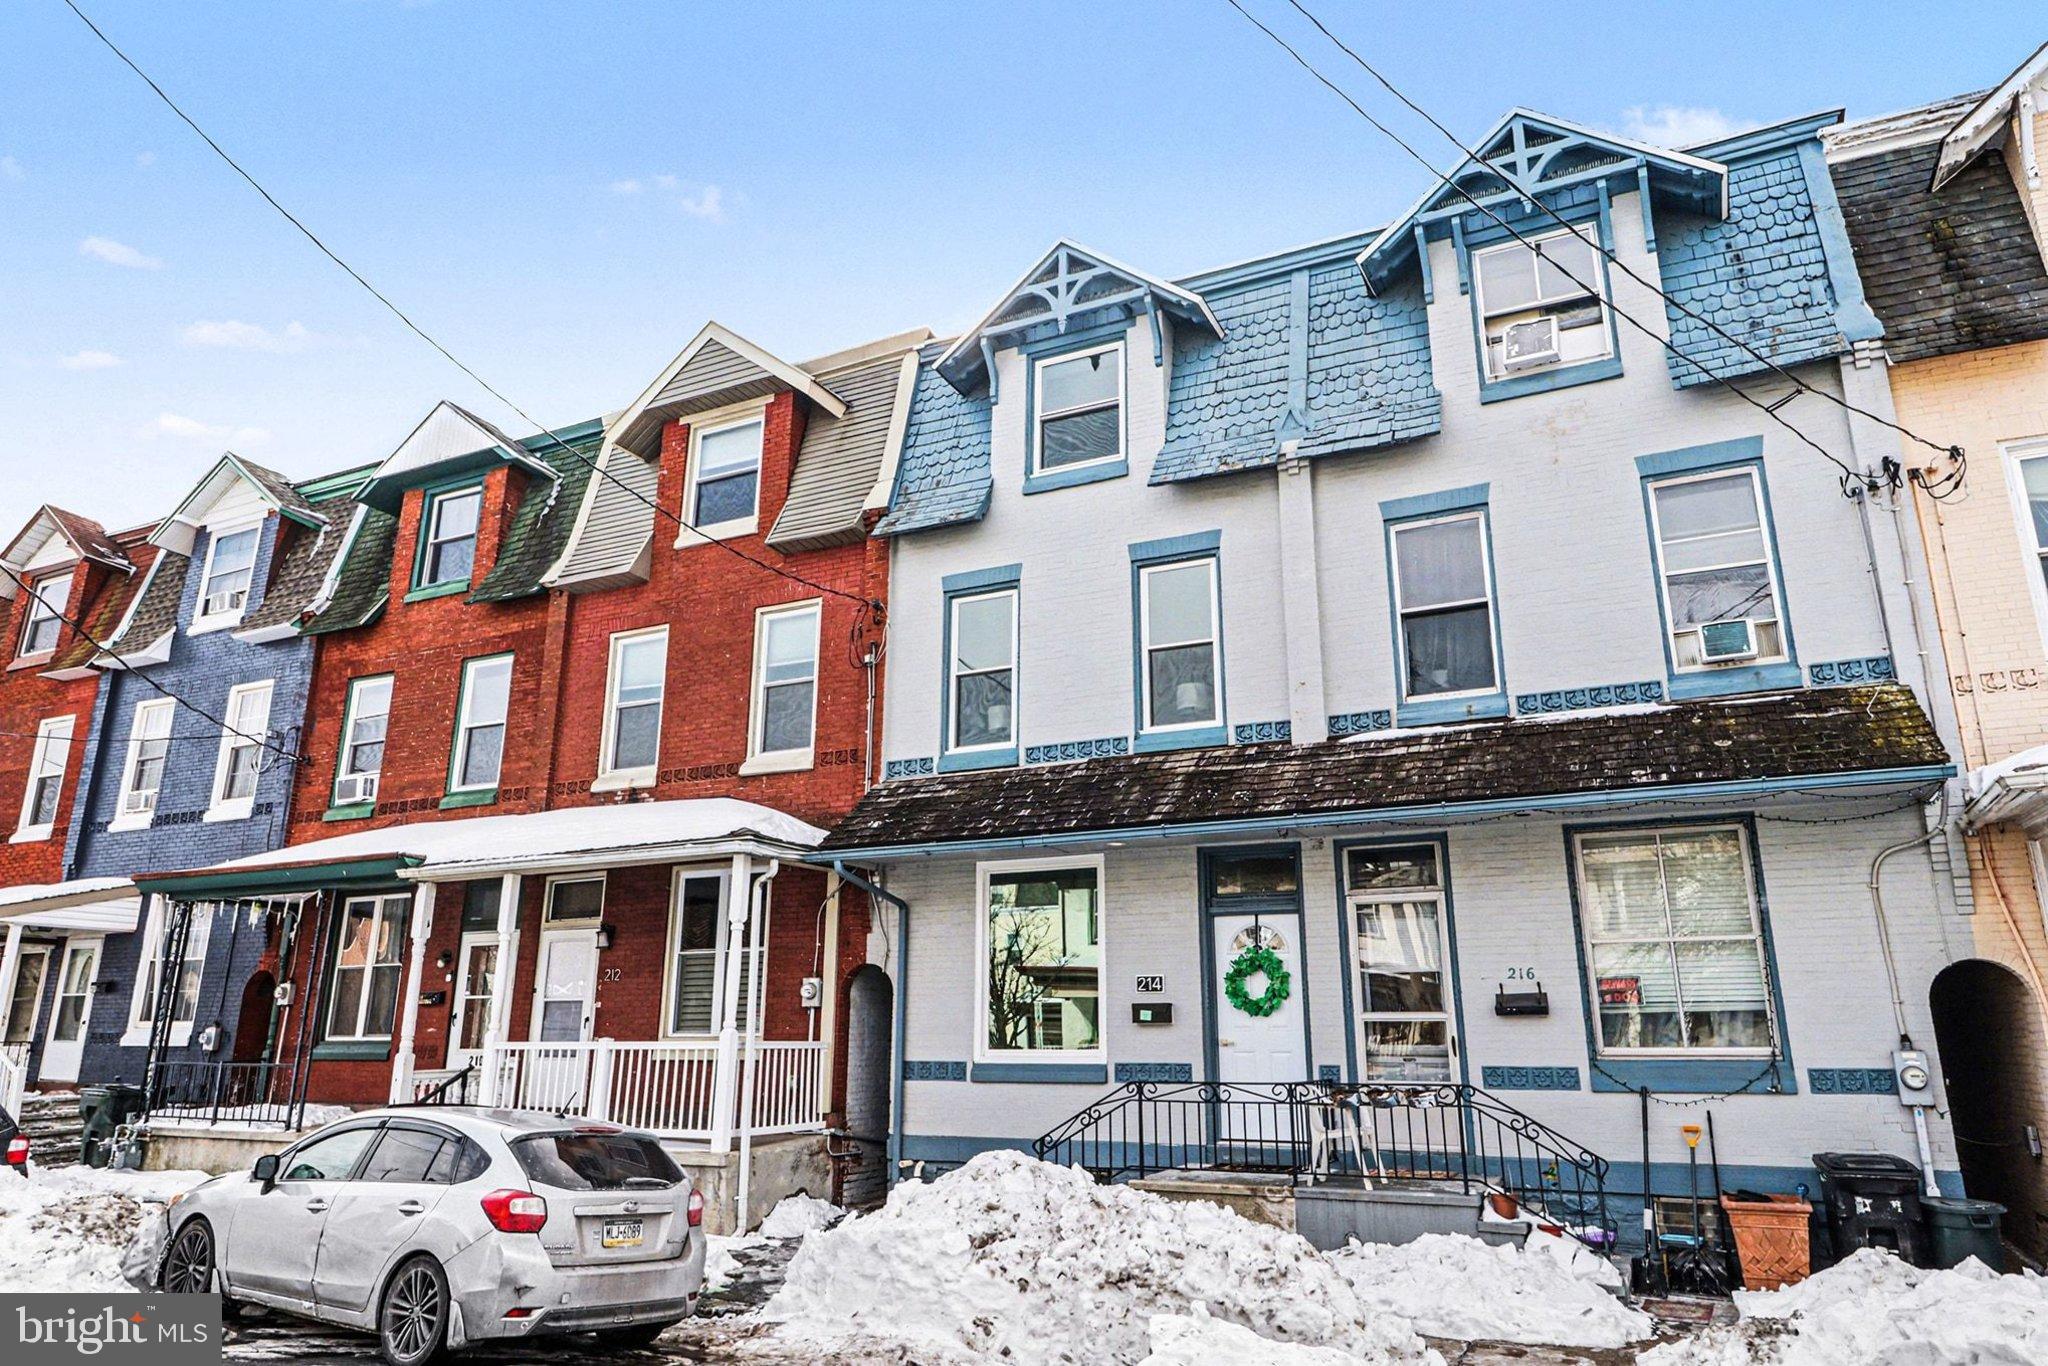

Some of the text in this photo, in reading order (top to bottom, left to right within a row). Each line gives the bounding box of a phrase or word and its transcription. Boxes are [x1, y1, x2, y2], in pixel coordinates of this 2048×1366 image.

[604, 968, 621, 981] 212
[1507, 967, 1535, 980] 216
[1137, 977, 1162, 991] 214
